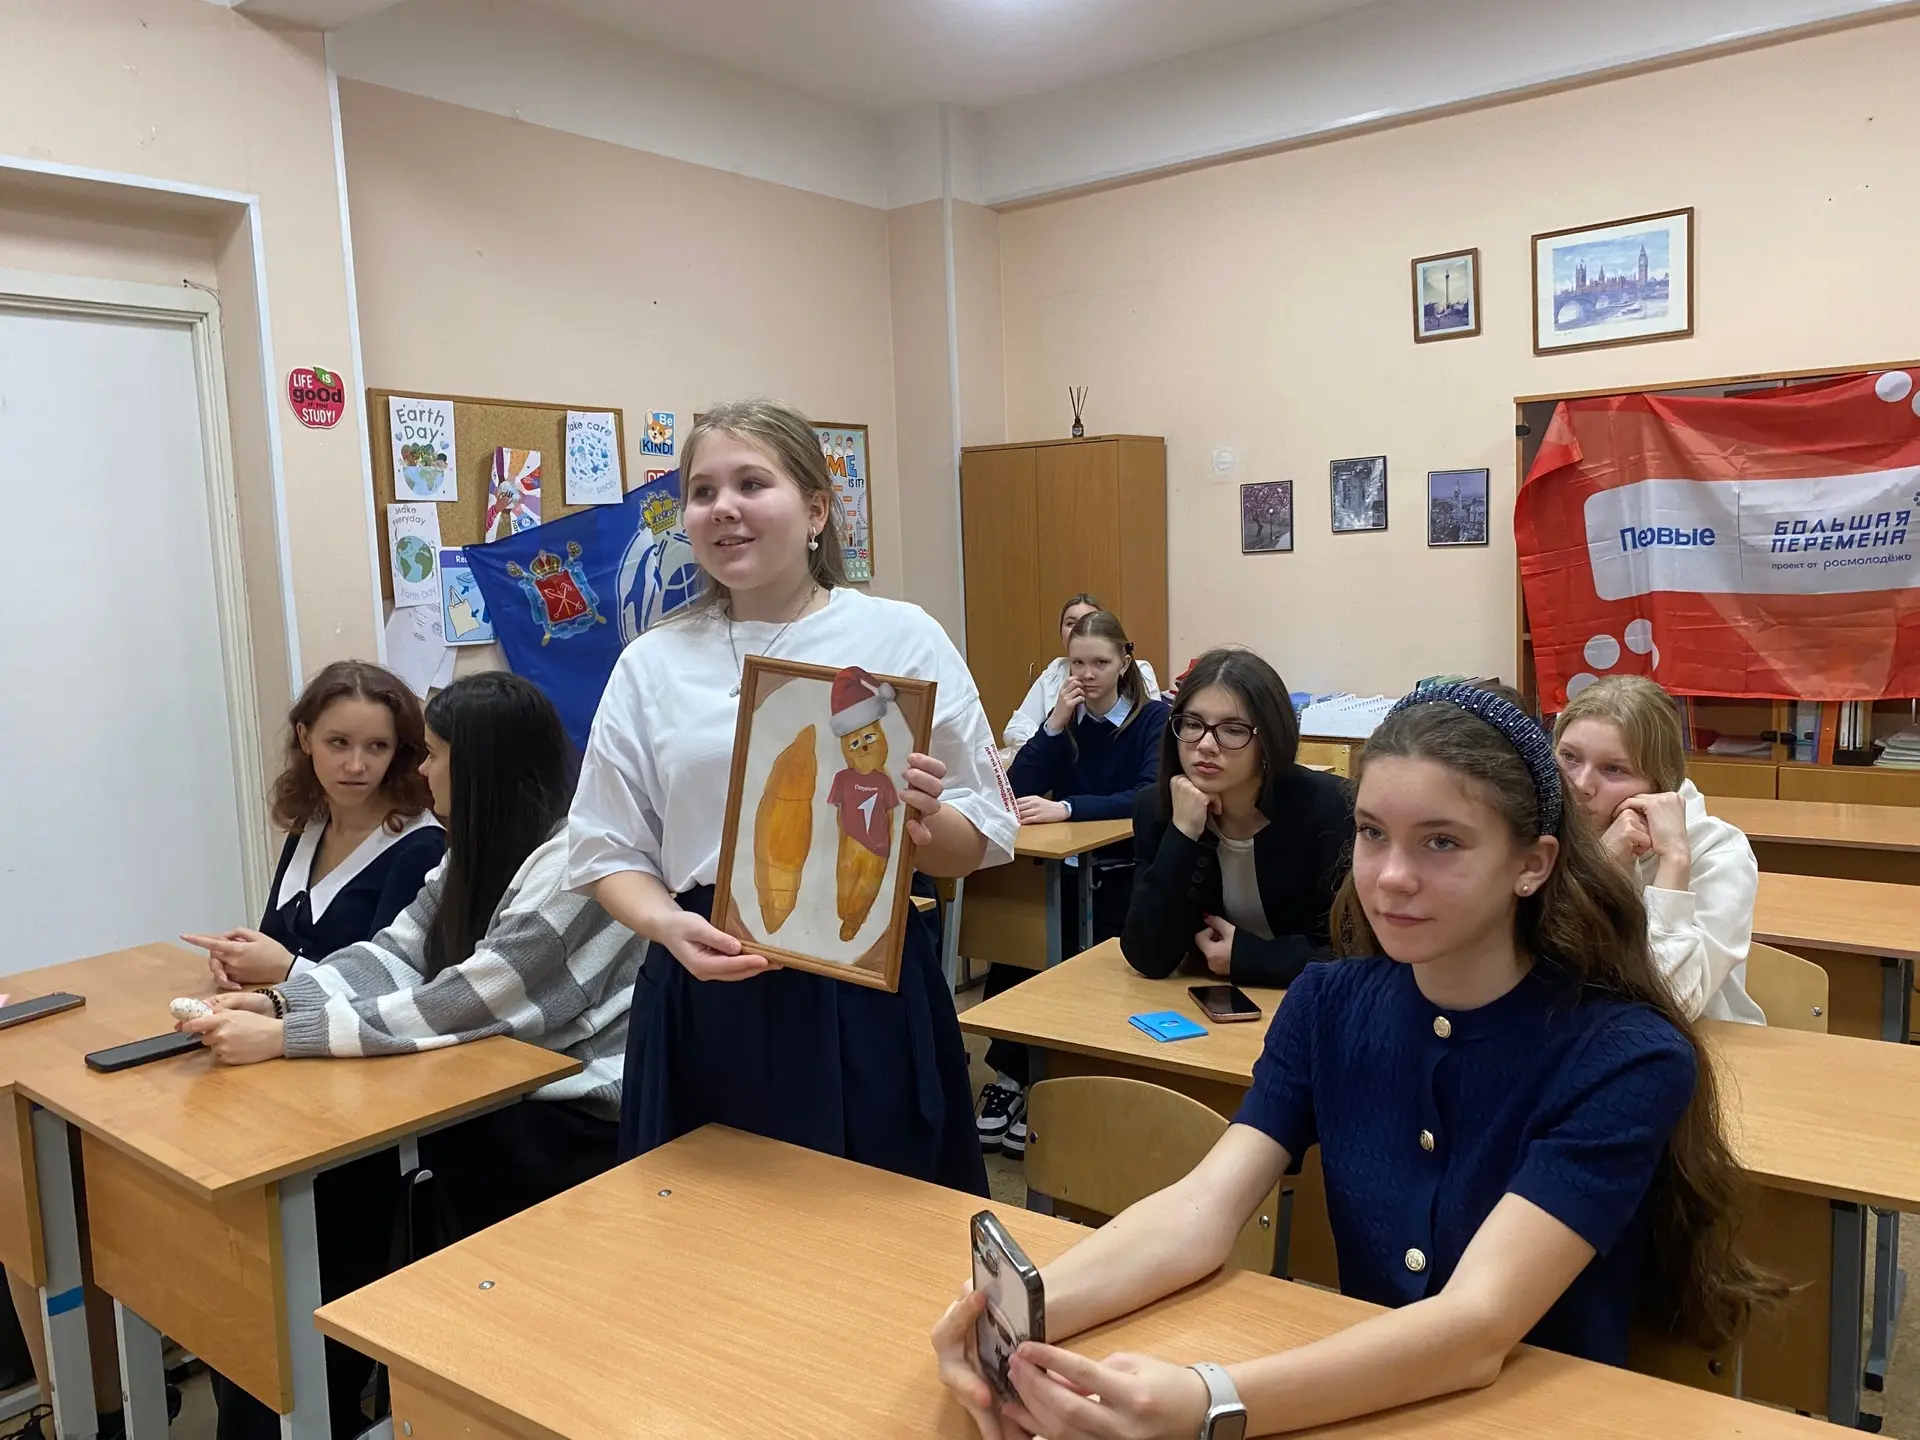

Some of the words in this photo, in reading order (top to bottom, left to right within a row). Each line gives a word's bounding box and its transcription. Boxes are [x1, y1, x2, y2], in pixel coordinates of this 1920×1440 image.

[293, 373, 313, 388] LIFE
[322, 374, 331, 383] IS
[302, 408, 335, 424] STUDY!
[396, 408, 445, 427] Earth
[659, 414, 673, 426] Be
[404, 426, 439, 443] Day
[587, 421, 612, 436] care
[642, 440, 673, 455] KIND!
[826, 455, 857, 477] ME
[848, 478, 855, 488] IS
[855, 479, 864, 488] IT?
[1774, 510, 1911, 535] БОЛЬШАЯ
[1771, 529, 1907, 553] ПЕРЕМЕНА
[1772, 561, 1804, 570] проект
[1823, 553, 1912, 570] росмолодёжь
